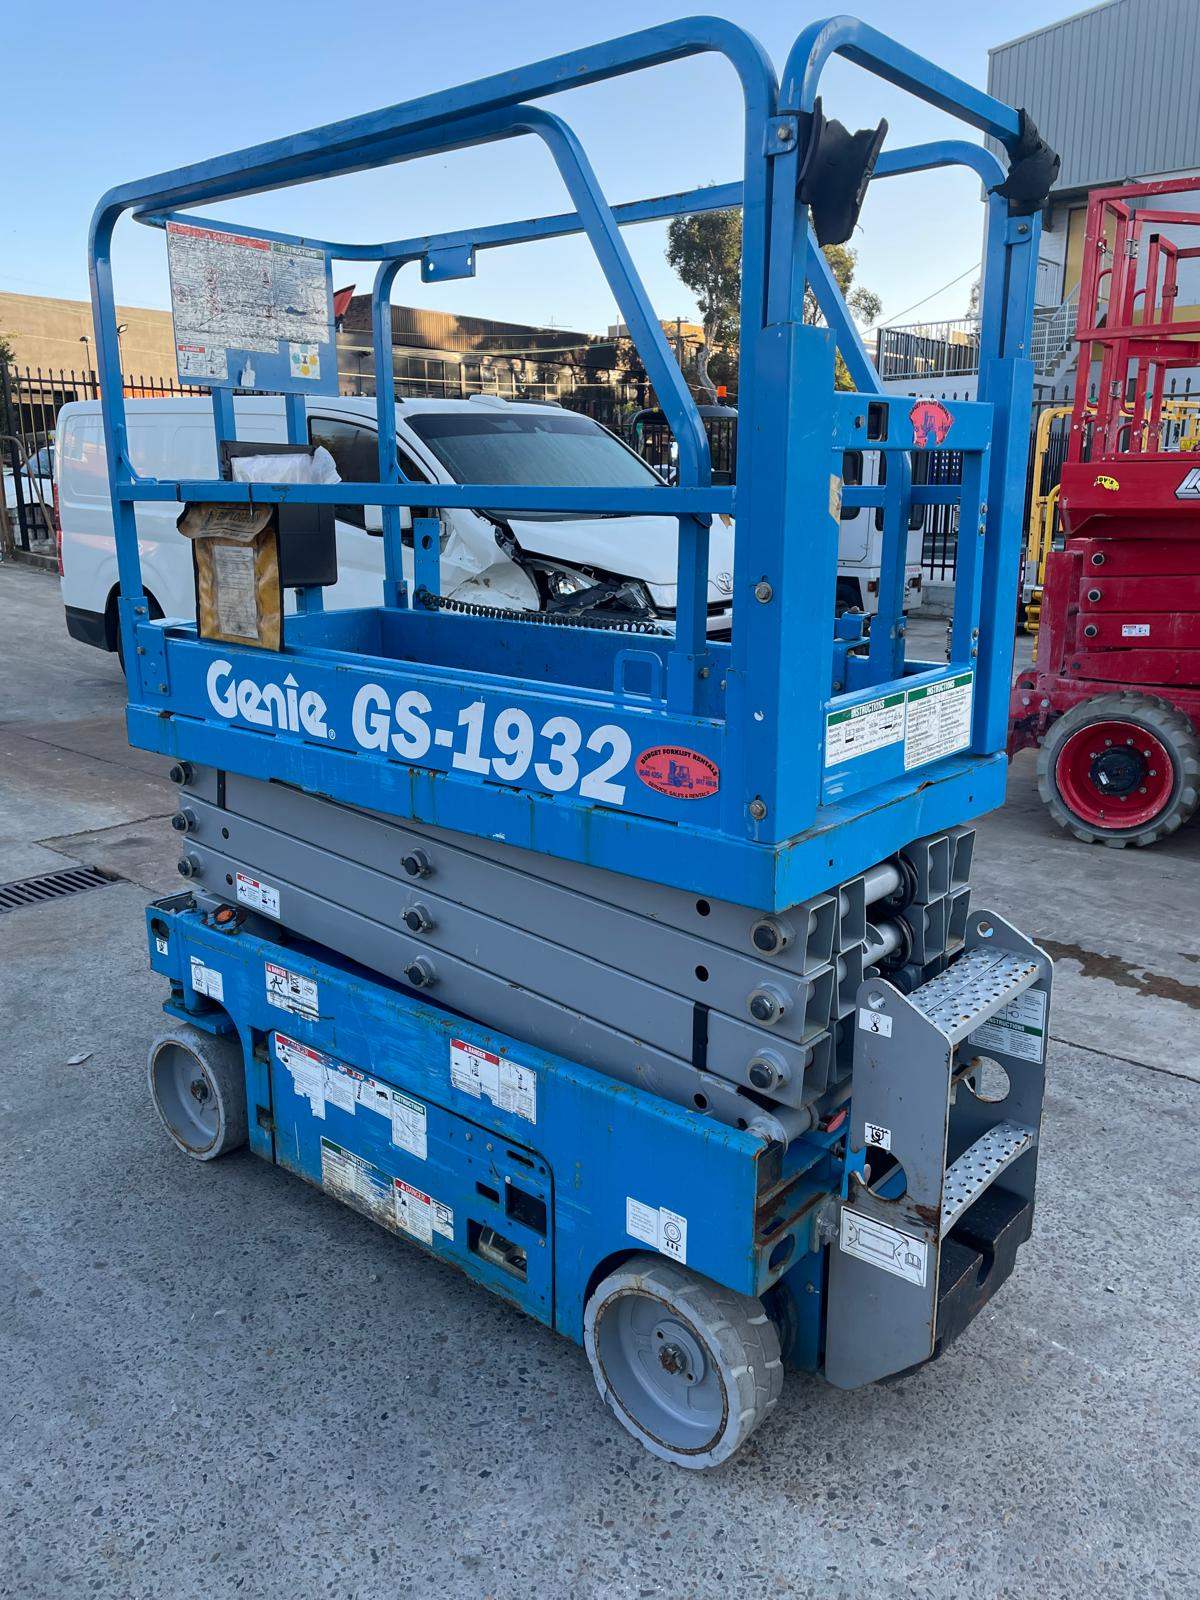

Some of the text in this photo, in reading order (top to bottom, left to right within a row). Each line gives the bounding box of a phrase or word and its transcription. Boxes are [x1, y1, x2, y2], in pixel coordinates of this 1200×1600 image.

[206, 659, 328, 739] Genie
[927, 679, 955, 696] INSTRUCTIONS
[851, 699, 885, 718] INSTRUCTIONS
[352, 683, 632, 805] GS-1932
[640, 748, 718, 777] BUDGET FORKLIFT RENTALS
[405, 1185, 426, 1201] DANGER
